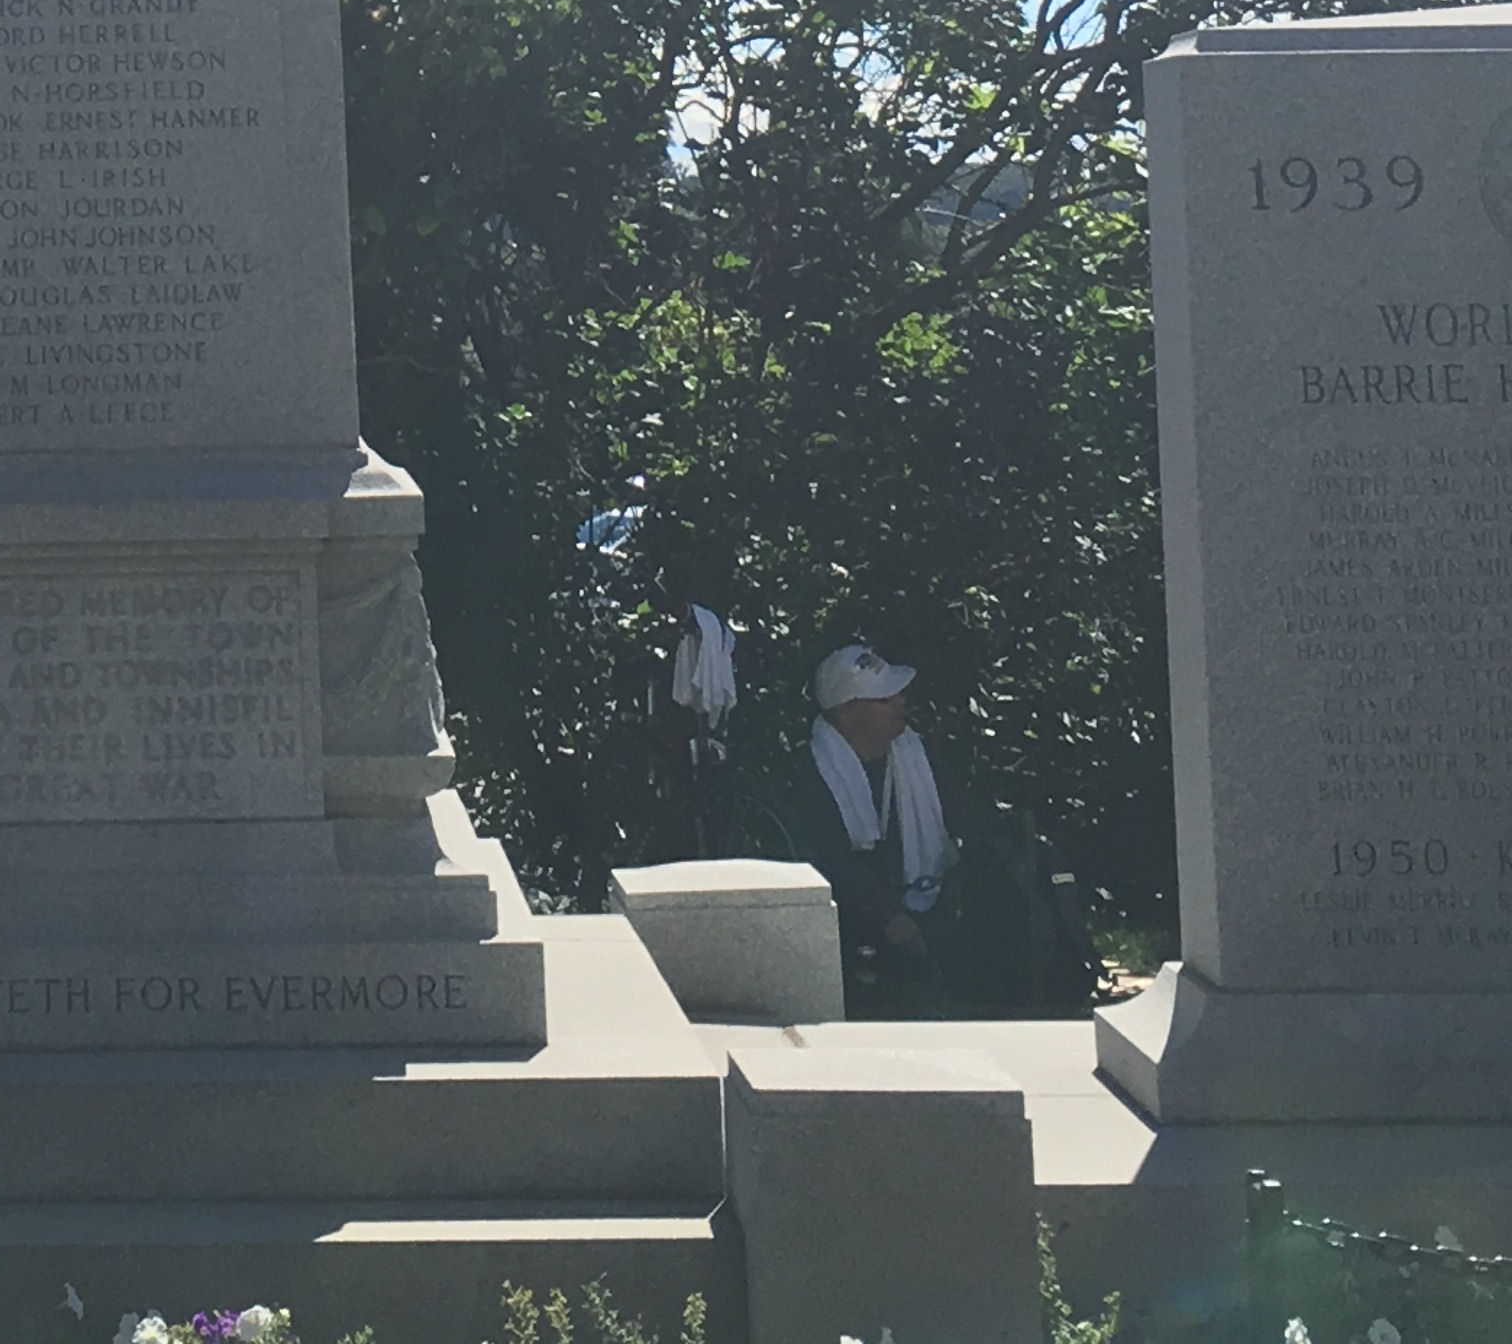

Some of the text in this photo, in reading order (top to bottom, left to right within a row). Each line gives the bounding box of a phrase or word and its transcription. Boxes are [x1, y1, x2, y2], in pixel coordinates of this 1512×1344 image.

[58, 23, 177, 45] HERRELL
[4, 54, 102, 74] VICTOR
[113, 50, 226, 72] HEWSON
[45, 80, 205, 102] HORSFIELD
[46, 110, 136, 131] ERNEST
[151, 108, 260, 130] HANMER
[38, 138, 184, 160] HARRISON
[92, 168, 166, 189] IRISH
[1248, 155, 1425, 212] 1939
[60, 197, 185, 219] JOURDAN
[7, 227, 77, 249] JOHN
[84, 224, 215, 249] JOHNSON
[62, 255, 167, 276] WALTER
[185, 253, 256, 274] LAKE
[130, 282, 244, 305] LAIDLAW
[84, 311, 224, 334] LAWRENCE
[25, 341, 208, 366] LIVINGSTONE
[47, 373, 182, 395] LONGMAN
[1299, 364, 1469, 404] BARRIE
[81, 586, 228, 615] MEMORY
[247, 585, 288, 615] OF
[12, 626, 58, 655] OF
[84, 624, 151, 653] THE
[186, 622, 294, 651] TOWN
[9, 662, 81, 690] AND
[97, 658, 294, 688] TOWNSHIPS
[32, 697, 107, 727] AND
[132, 695, 294, 724] INNISFIL
[17, 733, 126, 765] THEIR
[143, 732, 237, 762] LIVES
[258, 731, 297, 758] IN
[139, 771, 223, 802] WAR
[1333, 838, 1448, 877] 1950
[115, 977, 201, 1014] FOR
[224, 974, 468, 1013] EVERMORE
